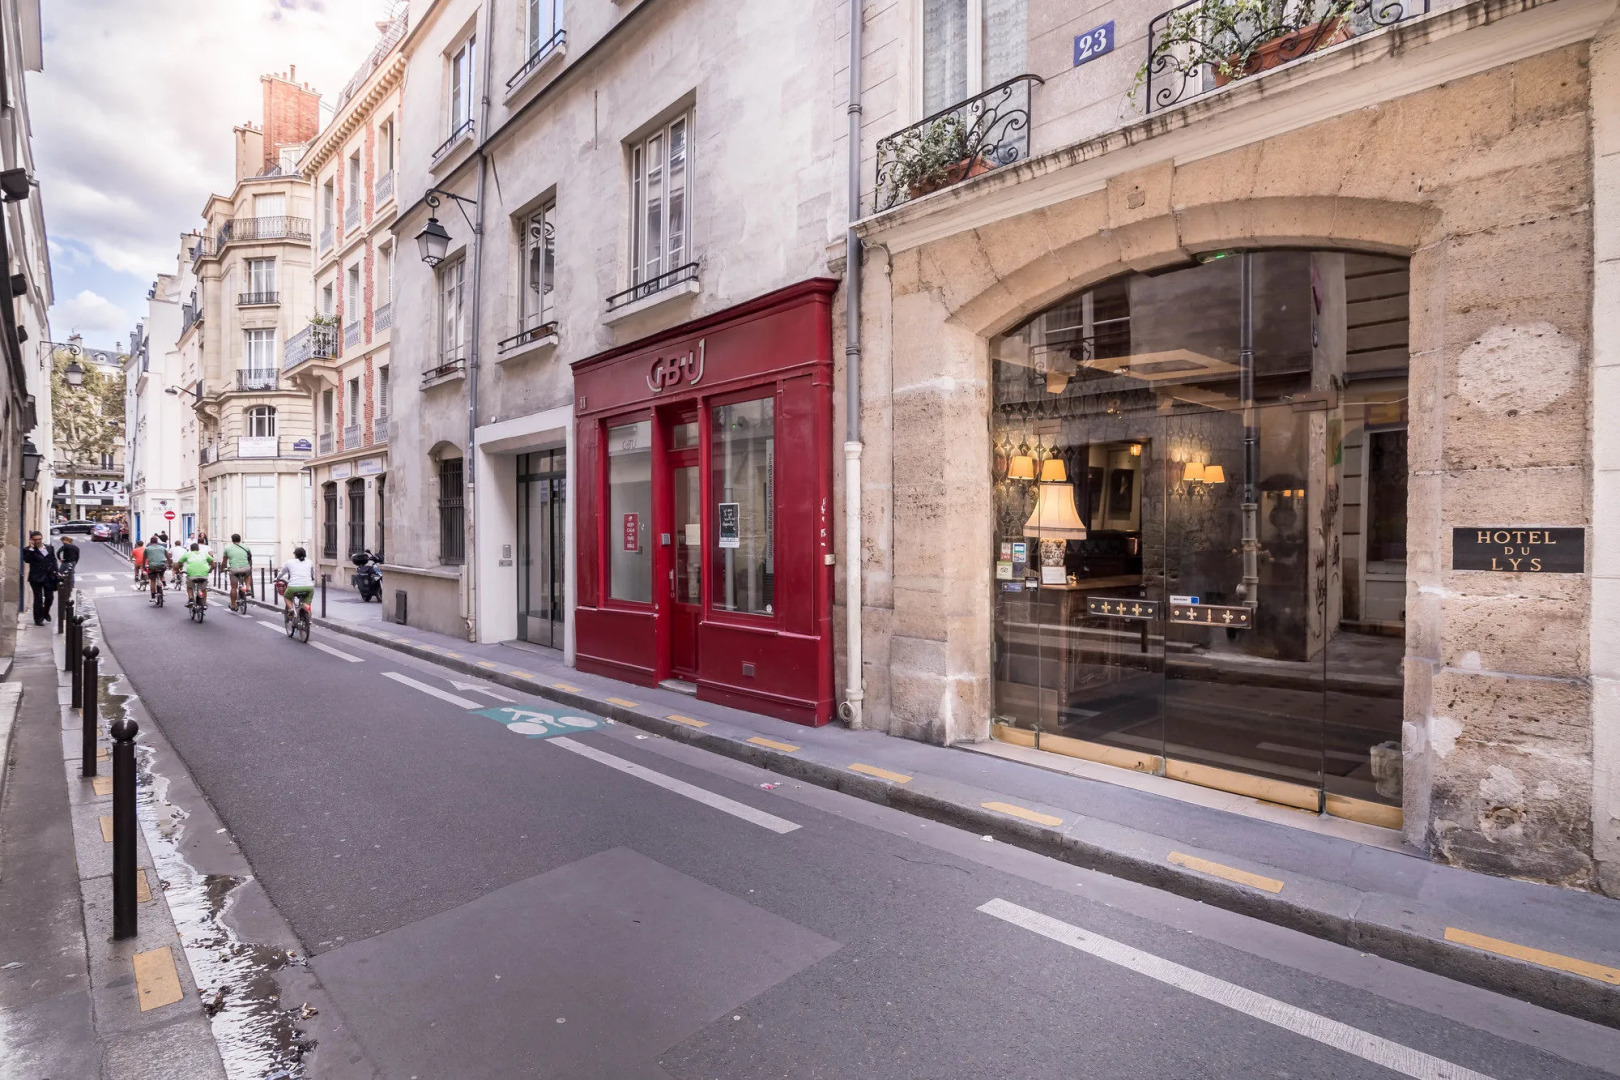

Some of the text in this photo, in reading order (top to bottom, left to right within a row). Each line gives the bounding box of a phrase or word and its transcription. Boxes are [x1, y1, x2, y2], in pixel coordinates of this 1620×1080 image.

[1079, 28, 1107, 61] 23
[646, 338, 706, 392] GBU
[1477, 531, 1557, 544] HOTEL
[1504, 546, 1530, 556] DU
[1491, 557, 1542, 572] LYS
